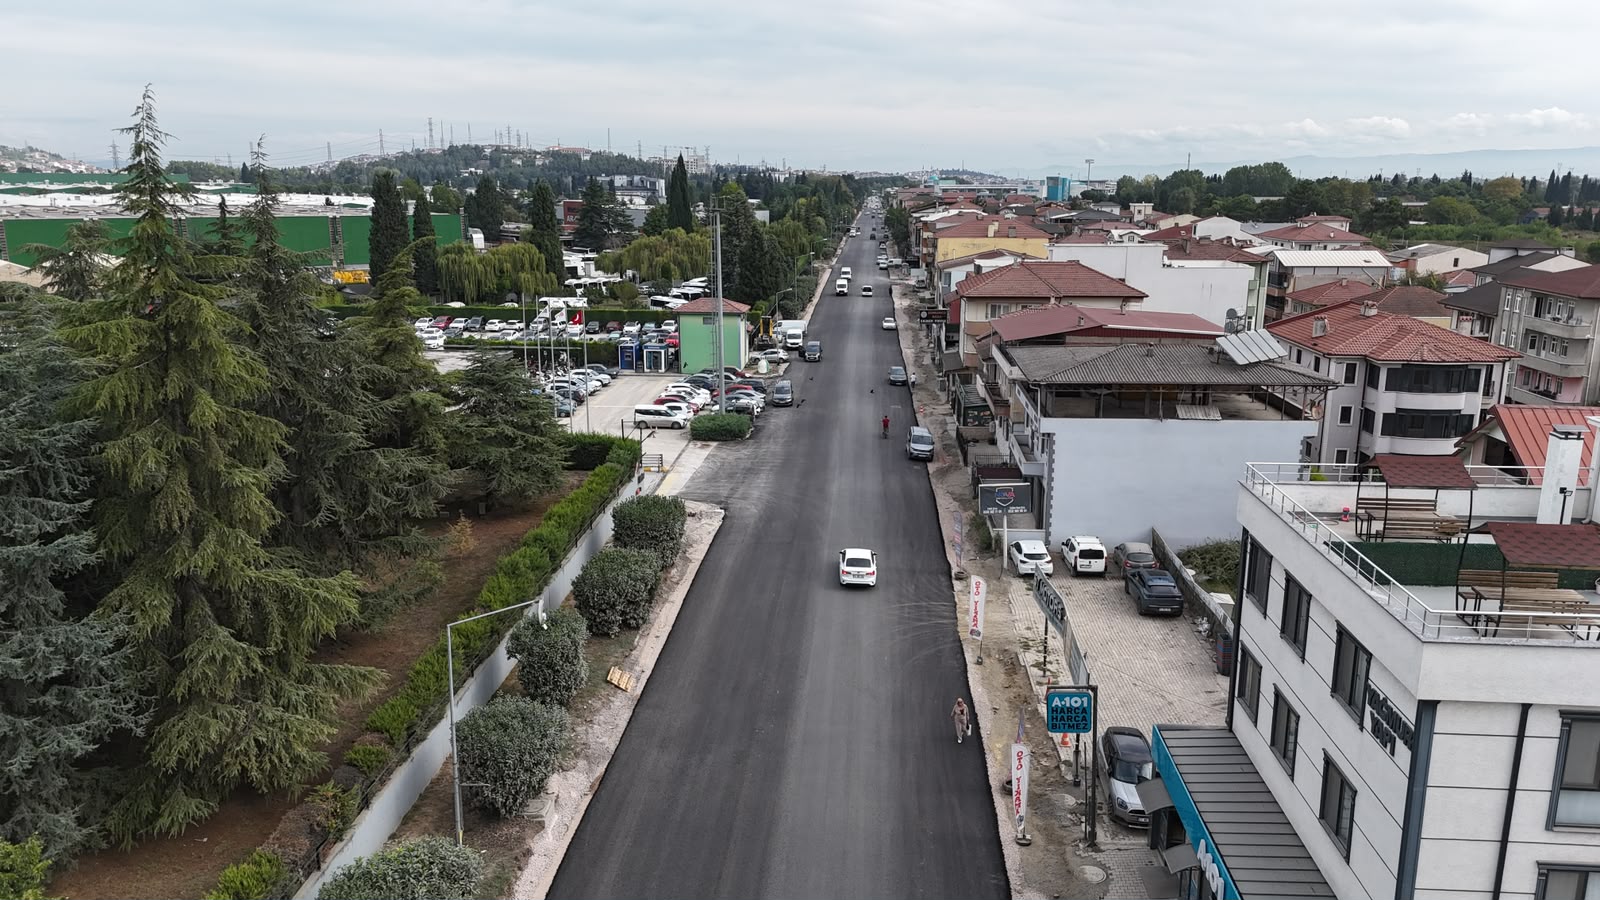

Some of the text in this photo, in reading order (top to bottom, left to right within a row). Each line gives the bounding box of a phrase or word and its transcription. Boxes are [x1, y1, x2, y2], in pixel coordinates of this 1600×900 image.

[1052, 707, 1088, 715] HARCA
[1052, 715, 1088, 723] HARCA
[1370, 710, 1396, 757] YAPI
